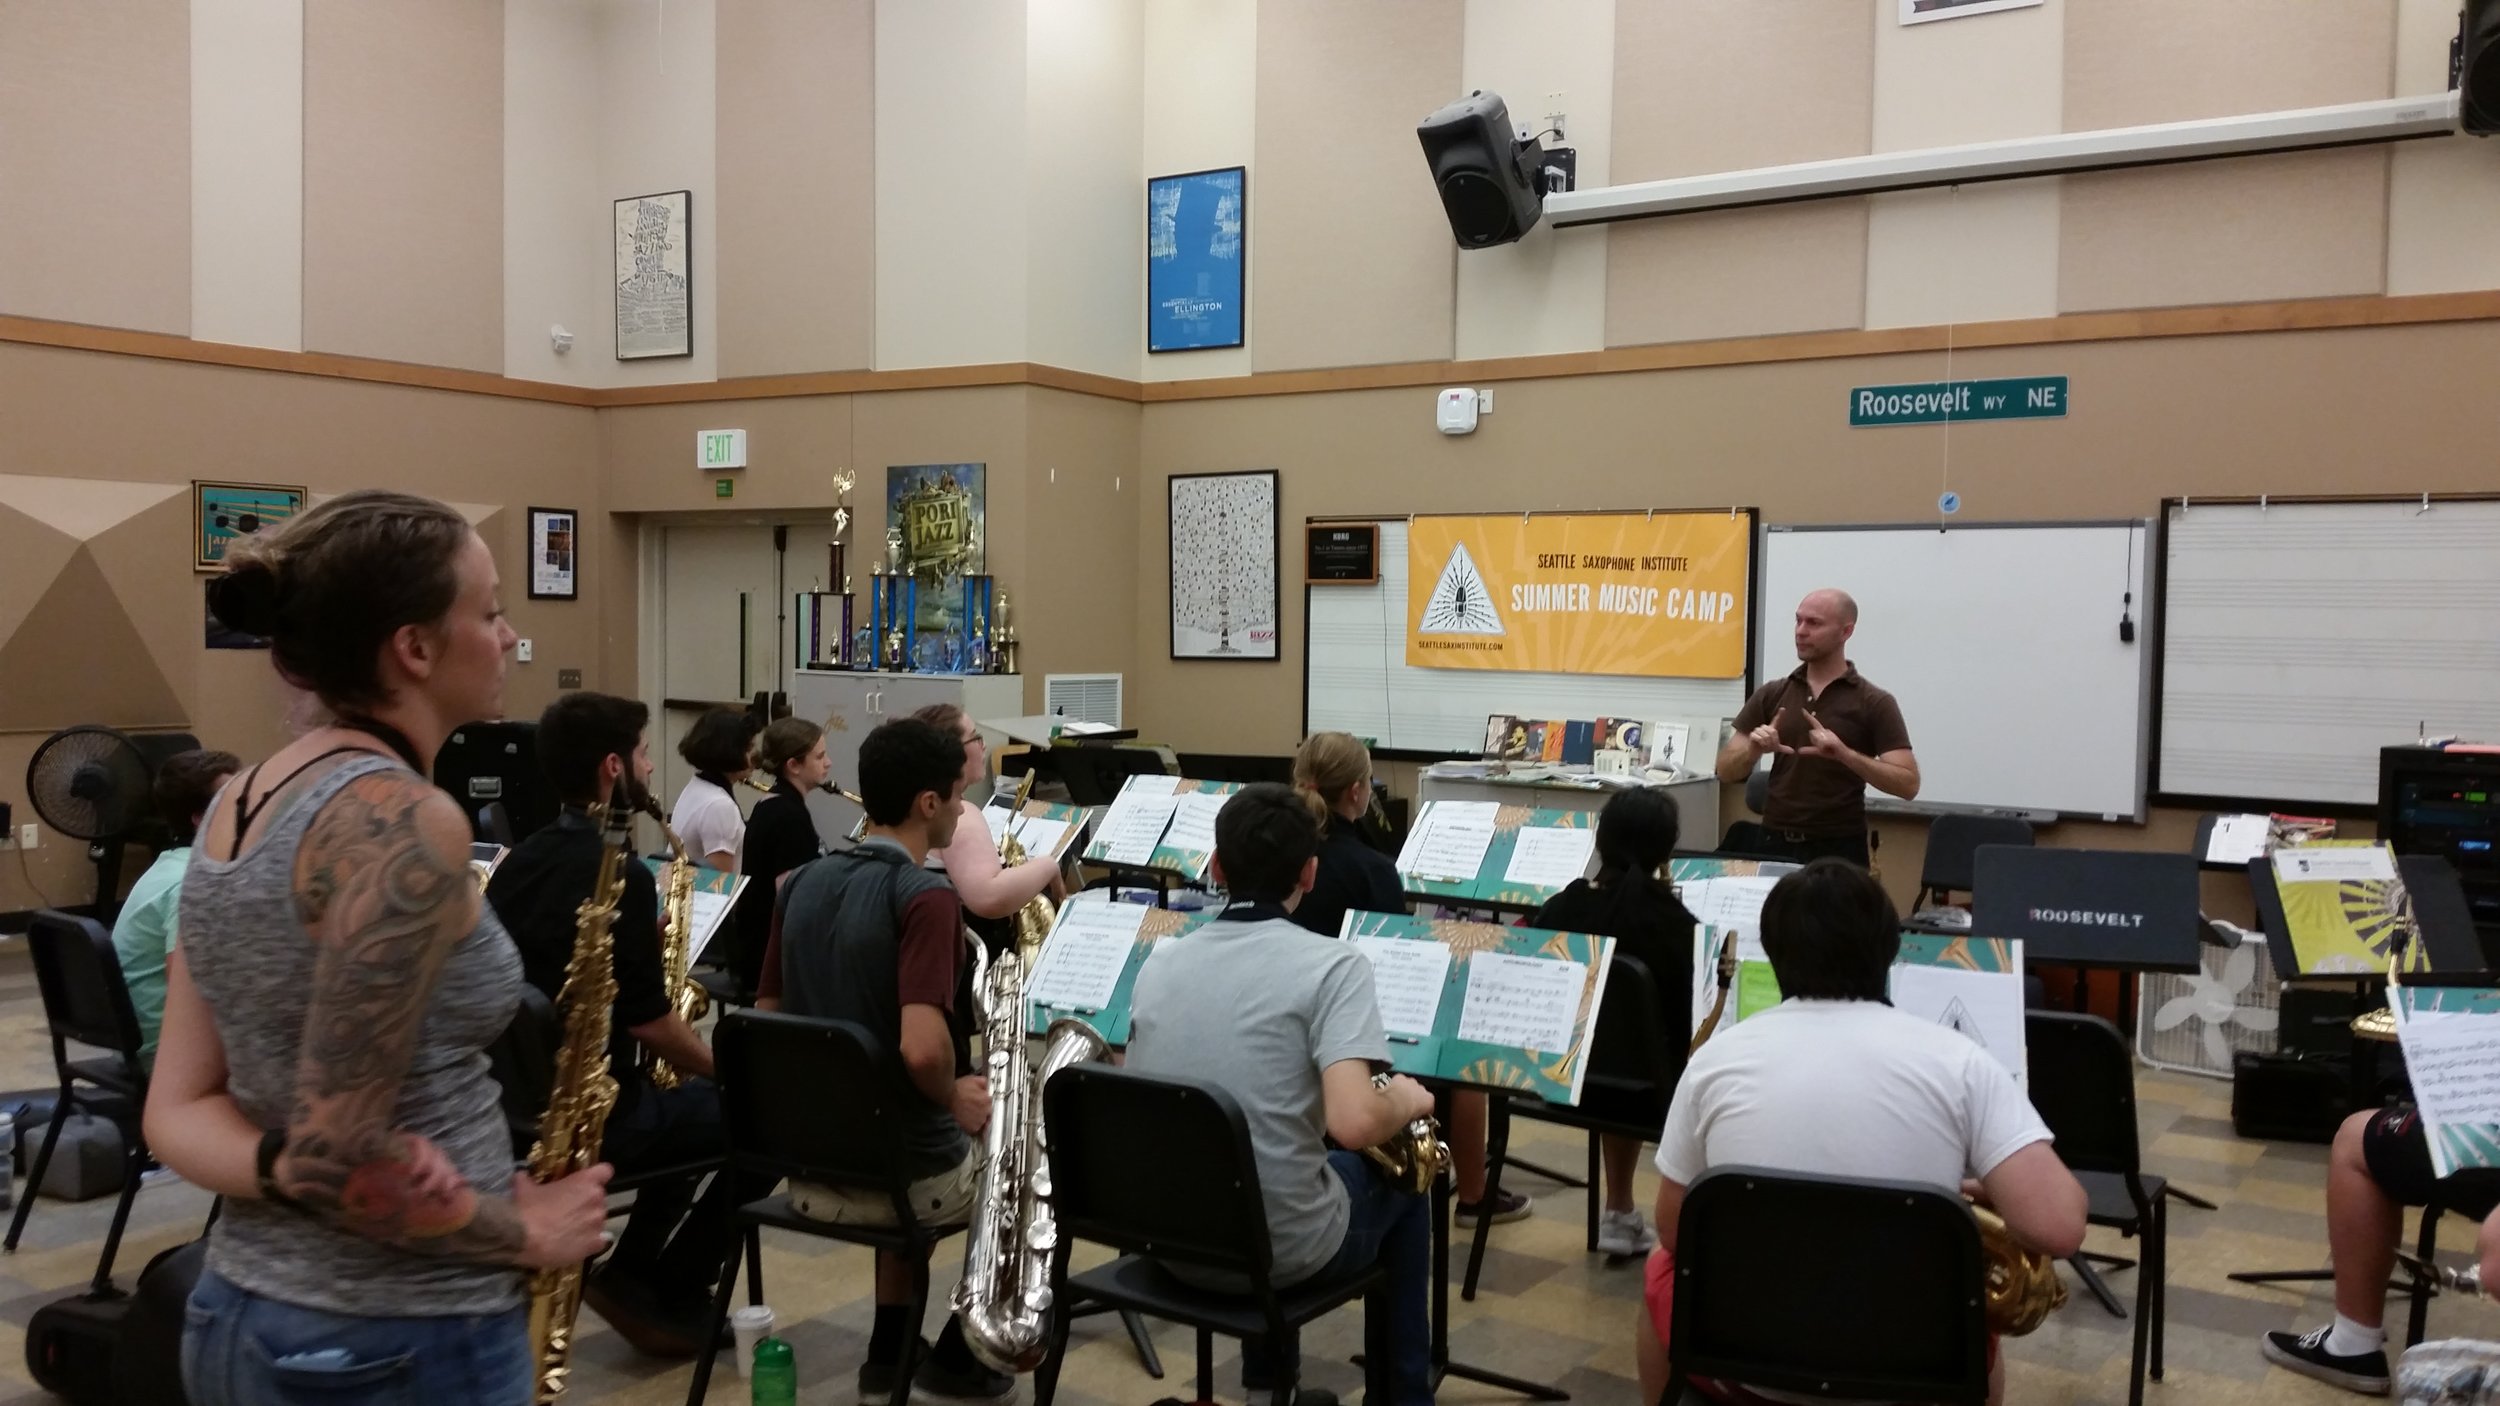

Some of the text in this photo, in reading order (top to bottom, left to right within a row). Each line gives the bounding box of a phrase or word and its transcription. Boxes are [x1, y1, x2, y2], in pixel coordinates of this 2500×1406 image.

[1174, 302, 1222, 314] ELLINGTON
[1859, 386, 2057, 416] Roosevelt WY NE
[707, 434, 733, 462] EXIT
[914, 502, 956, 525] PORI
[914, 522, 954, 550] JAZZ
[1538, 554, 1688, 571] SEATTLE SAXOPHONE INSTITUTE
[1511, 583, 1734, 623] SUMMER MUSIC CAMP
[1418, 641, 1503, 650] SEATTLESAXINSTITUTE.COM
[2029, 908, 2144, 928] ROOSEVELT
